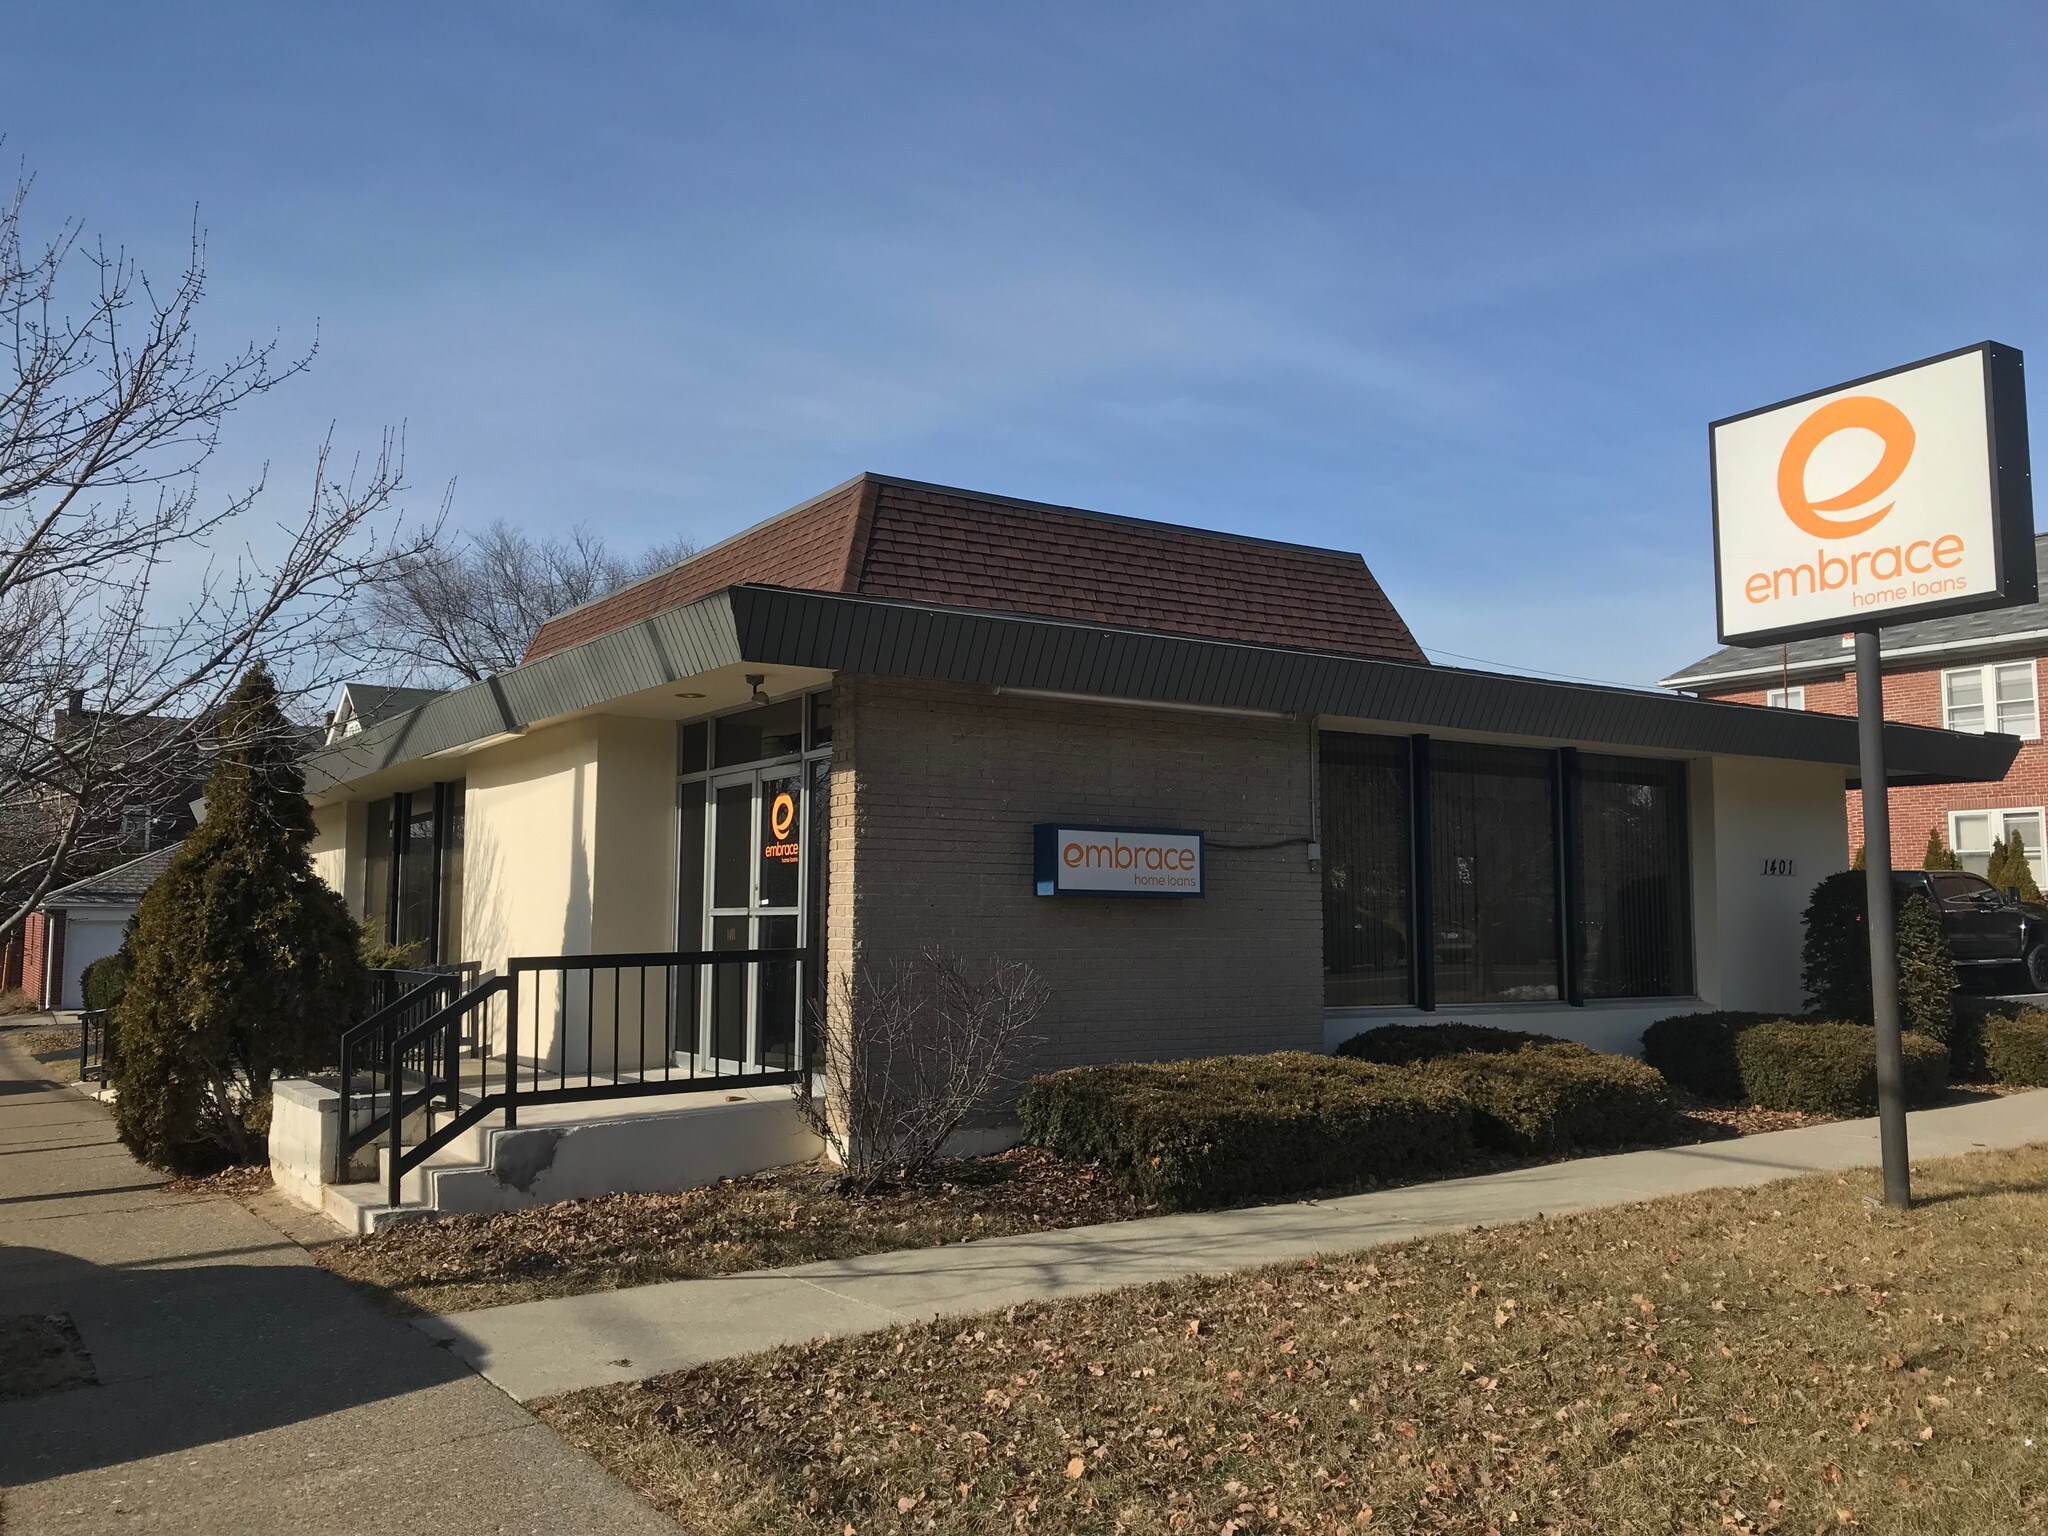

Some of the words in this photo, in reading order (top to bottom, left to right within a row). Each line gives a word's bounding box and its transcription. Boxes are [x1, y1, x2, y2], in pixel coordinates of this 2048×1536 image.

[1745, 534, 1965, 604] embrace
[1852, 587, 1906, 608] home
[1912, 576, 1967, 596] loans
[765, 841, 799, 858] embrace
[1063, 838, 1196, 871] embrace
[1764, 859, 1793, 875] 1401
[1134, 874, 1165, 886] home
[1167, 875, 1196, 887] loans
